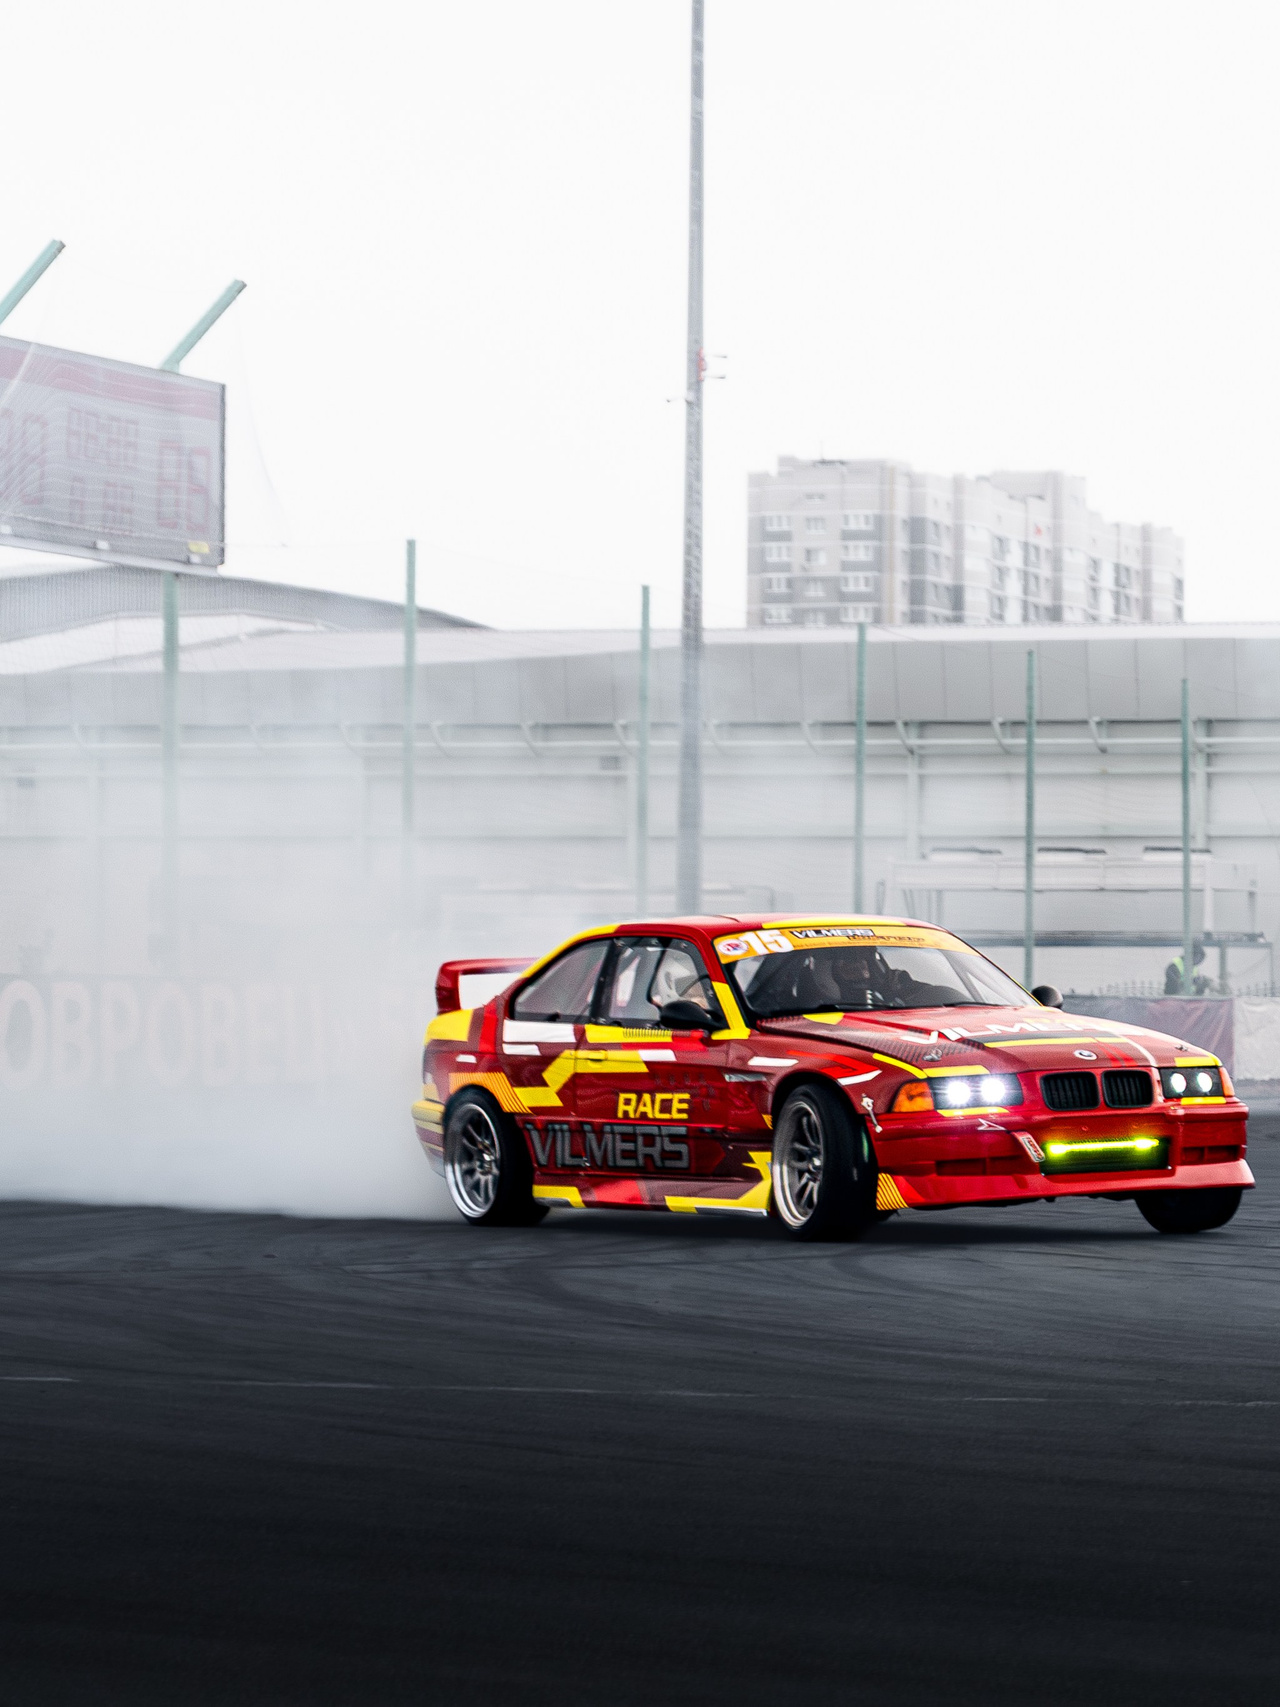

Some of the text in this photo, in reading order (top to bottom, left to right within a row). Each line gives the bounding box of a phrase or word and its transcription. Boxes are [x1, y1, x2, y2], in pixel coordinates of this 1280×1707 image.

[738, 930, 794, 956] 15
[617, 1092, 691, 1119] RACE
[525, 1123, 689, 1168] VILMERS
